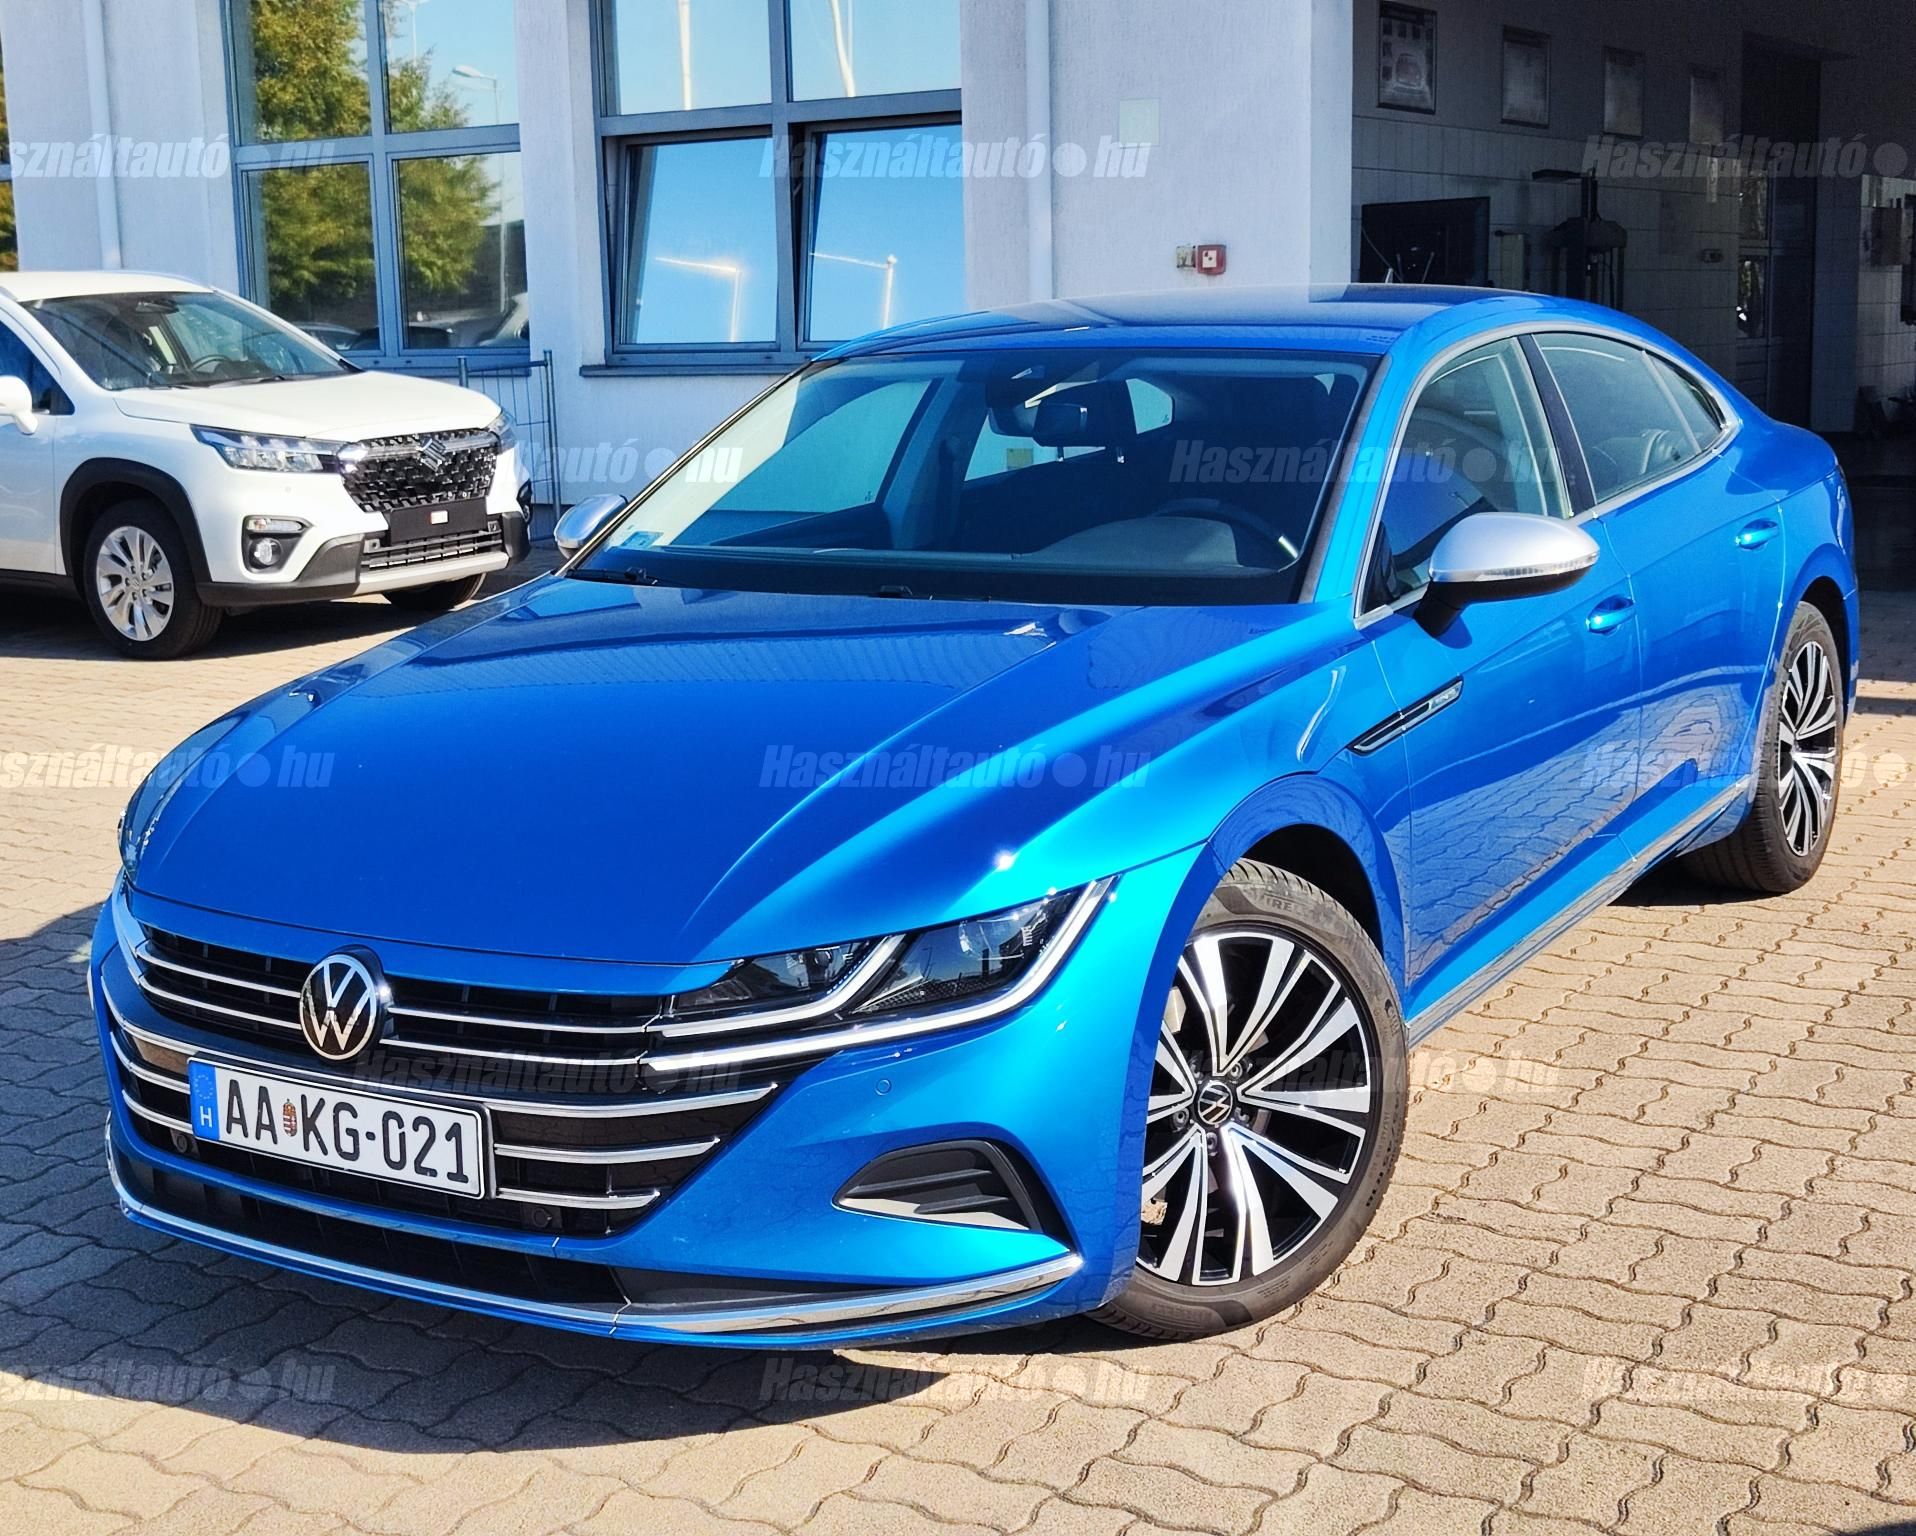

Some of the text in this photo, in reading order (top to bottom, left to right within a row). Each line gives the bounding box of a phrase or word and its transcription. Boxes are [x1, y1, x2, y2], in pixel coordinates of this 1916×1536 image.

[199, 1104, 213, 1128] H
[226, 1078, 469, 1184] AA KG-021
